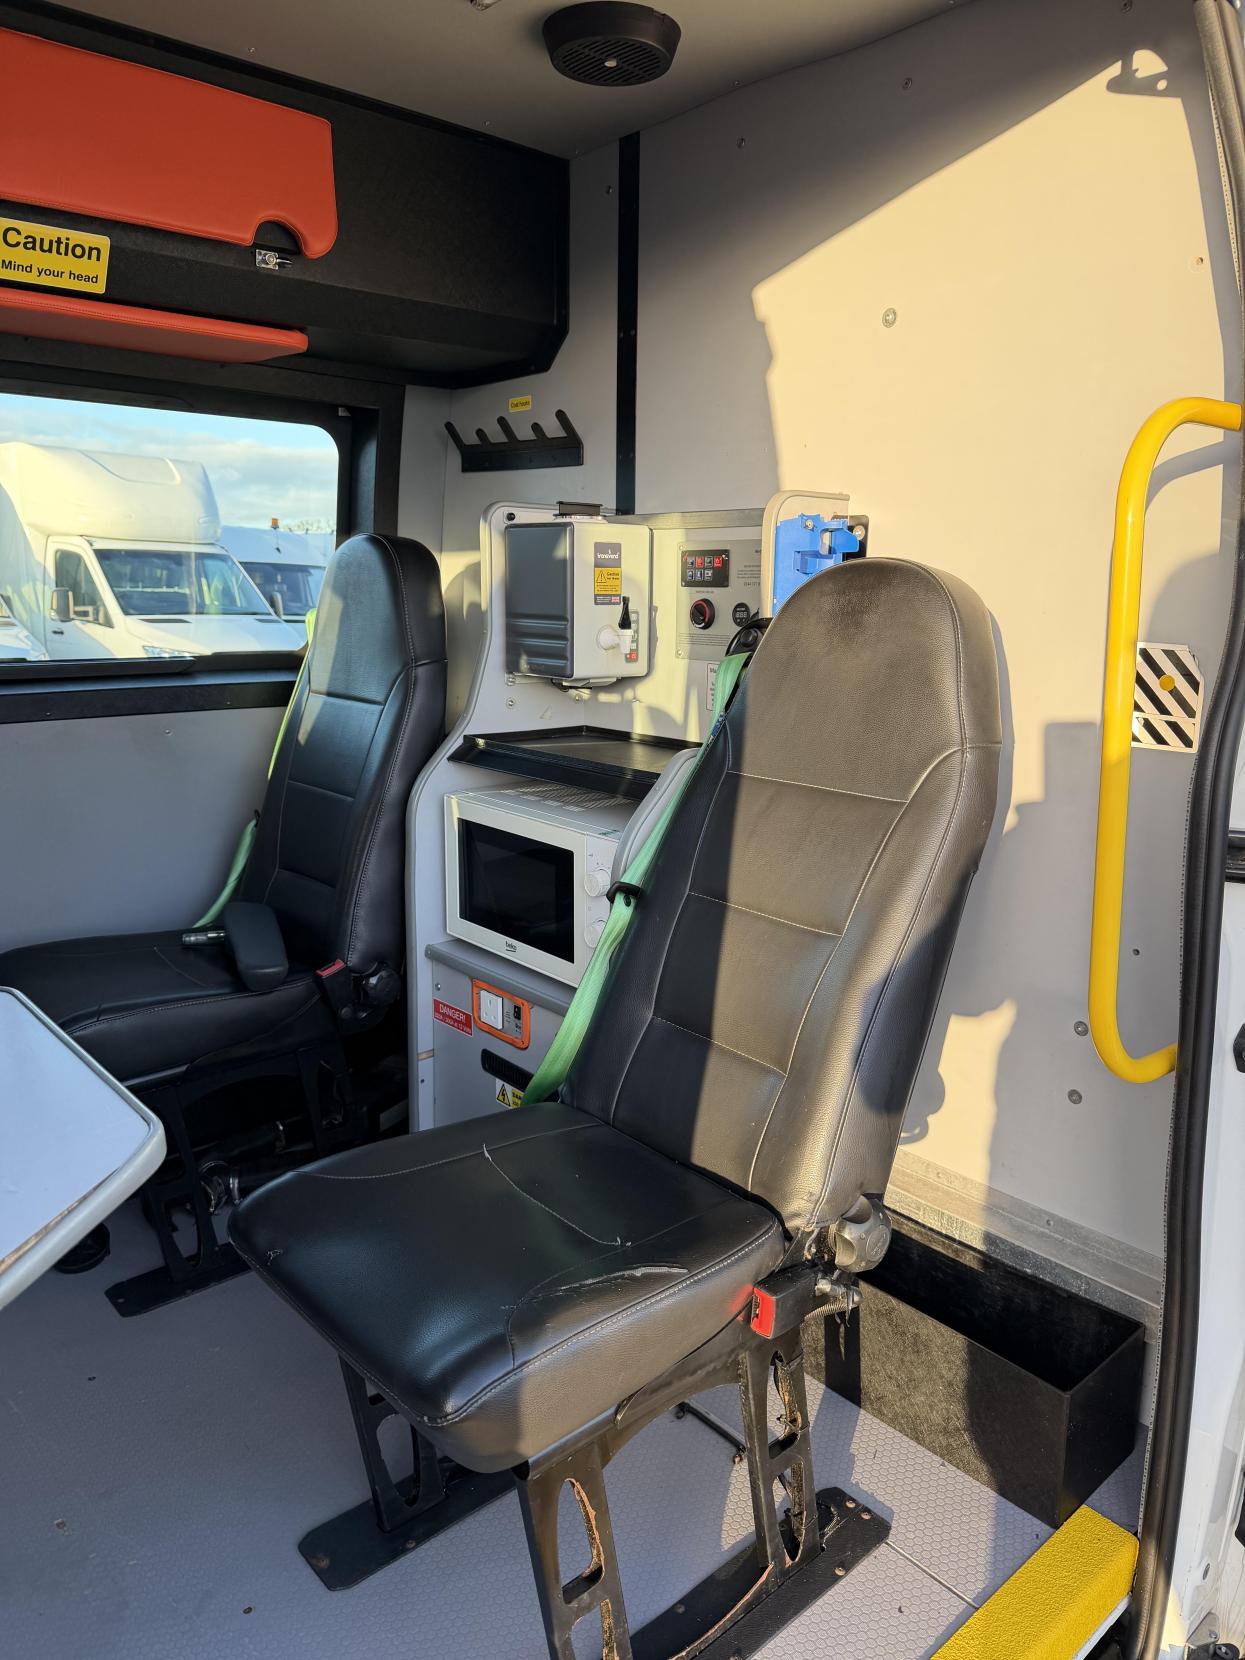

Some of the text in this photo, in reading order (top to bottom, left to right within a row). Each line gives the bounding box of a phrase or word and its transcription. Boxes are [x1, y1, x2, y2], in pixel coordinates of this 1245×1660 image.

[2, 226, 102, 262] Caution
[1, 259, 98, 284] Mind your head
[505, 940, 517, 951] beko
[439, 1003, 466, 1023] DANGER!
